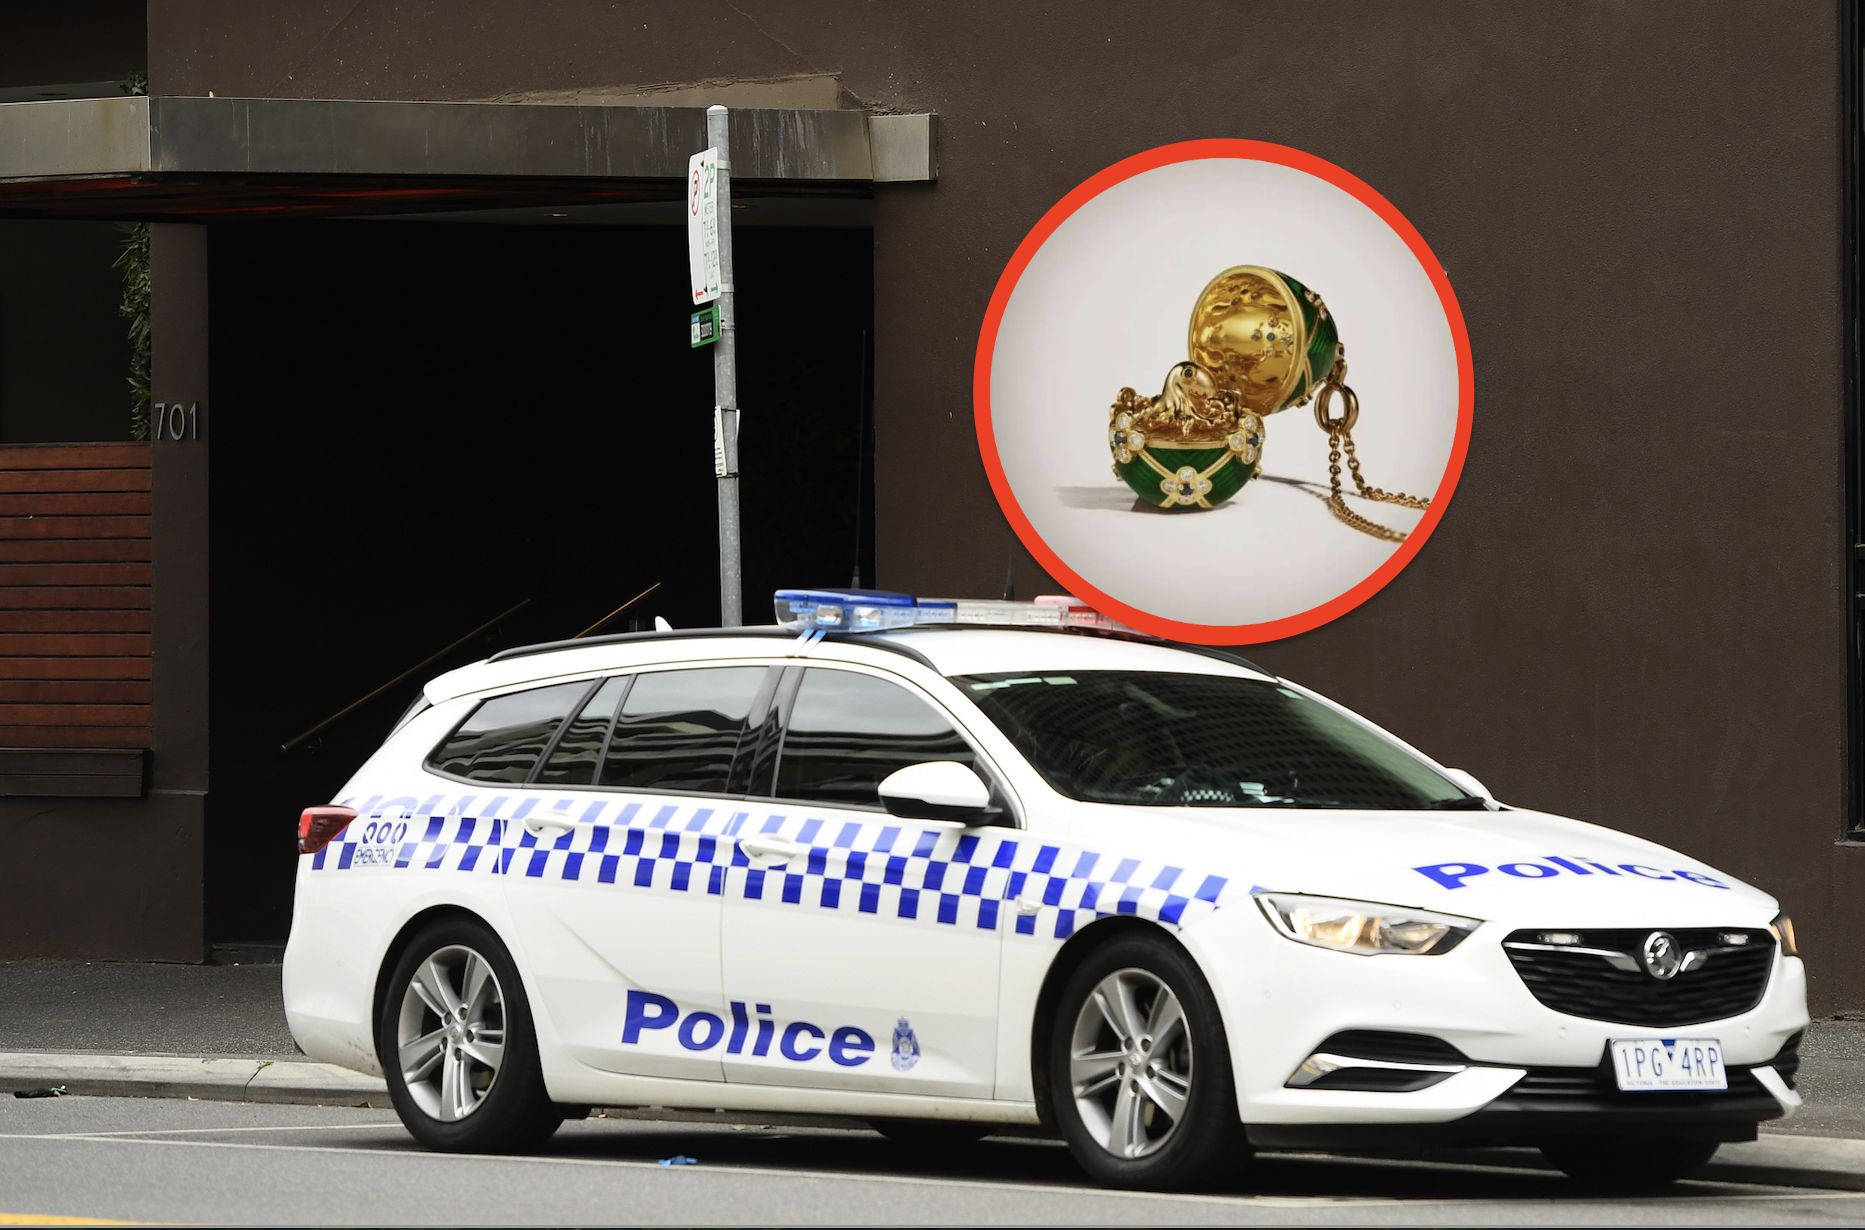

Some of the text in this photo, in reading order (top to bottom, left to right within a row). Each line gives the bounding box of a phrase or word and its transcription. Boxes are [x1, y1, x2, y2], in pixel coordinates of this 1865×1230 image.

[703, 162, 715, 199] 2P
[154, 402, 196, 440] 701
[362, 822, 407, 844] 000
[1412, 855, 1731, 890] Police
[621, 989, 875, 1067] Police
[1622, 1047, 1718, 1077] 1PG 4RP
